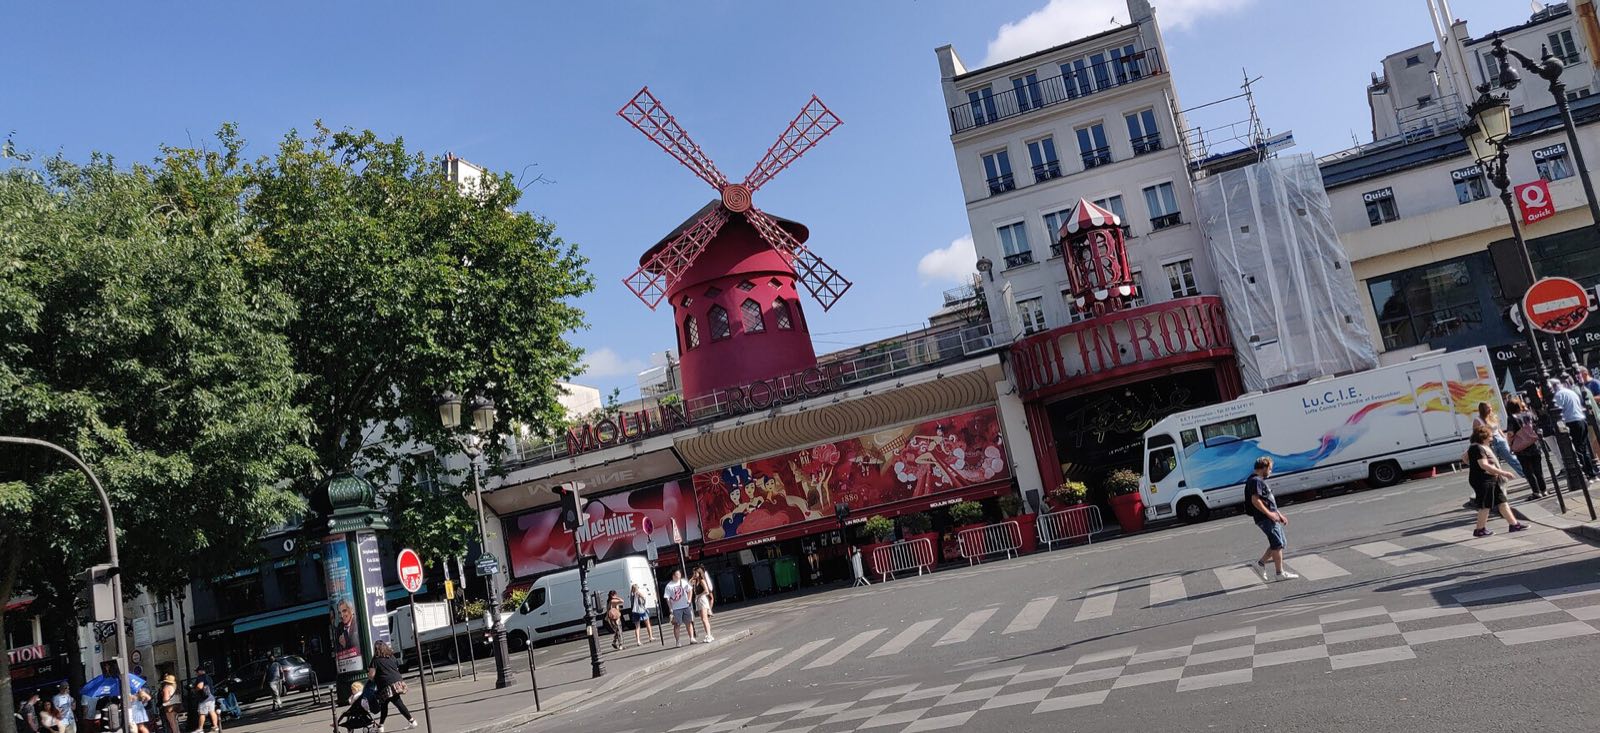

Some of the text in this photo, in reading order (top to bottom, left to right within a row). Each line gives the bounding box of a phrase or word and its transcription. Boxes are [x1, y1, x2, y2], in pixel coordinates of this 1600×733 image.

[1534, 143, 1566, 159] Quick
[1452, 166, 1482, 179] Quick
[1363, 188, 1392, 201] Quick
[1527, 209, 1552, 222] Quick
[565, 362, 842, 456] MOULIN ROUGE
[841, 494, 859, 503] 1889
